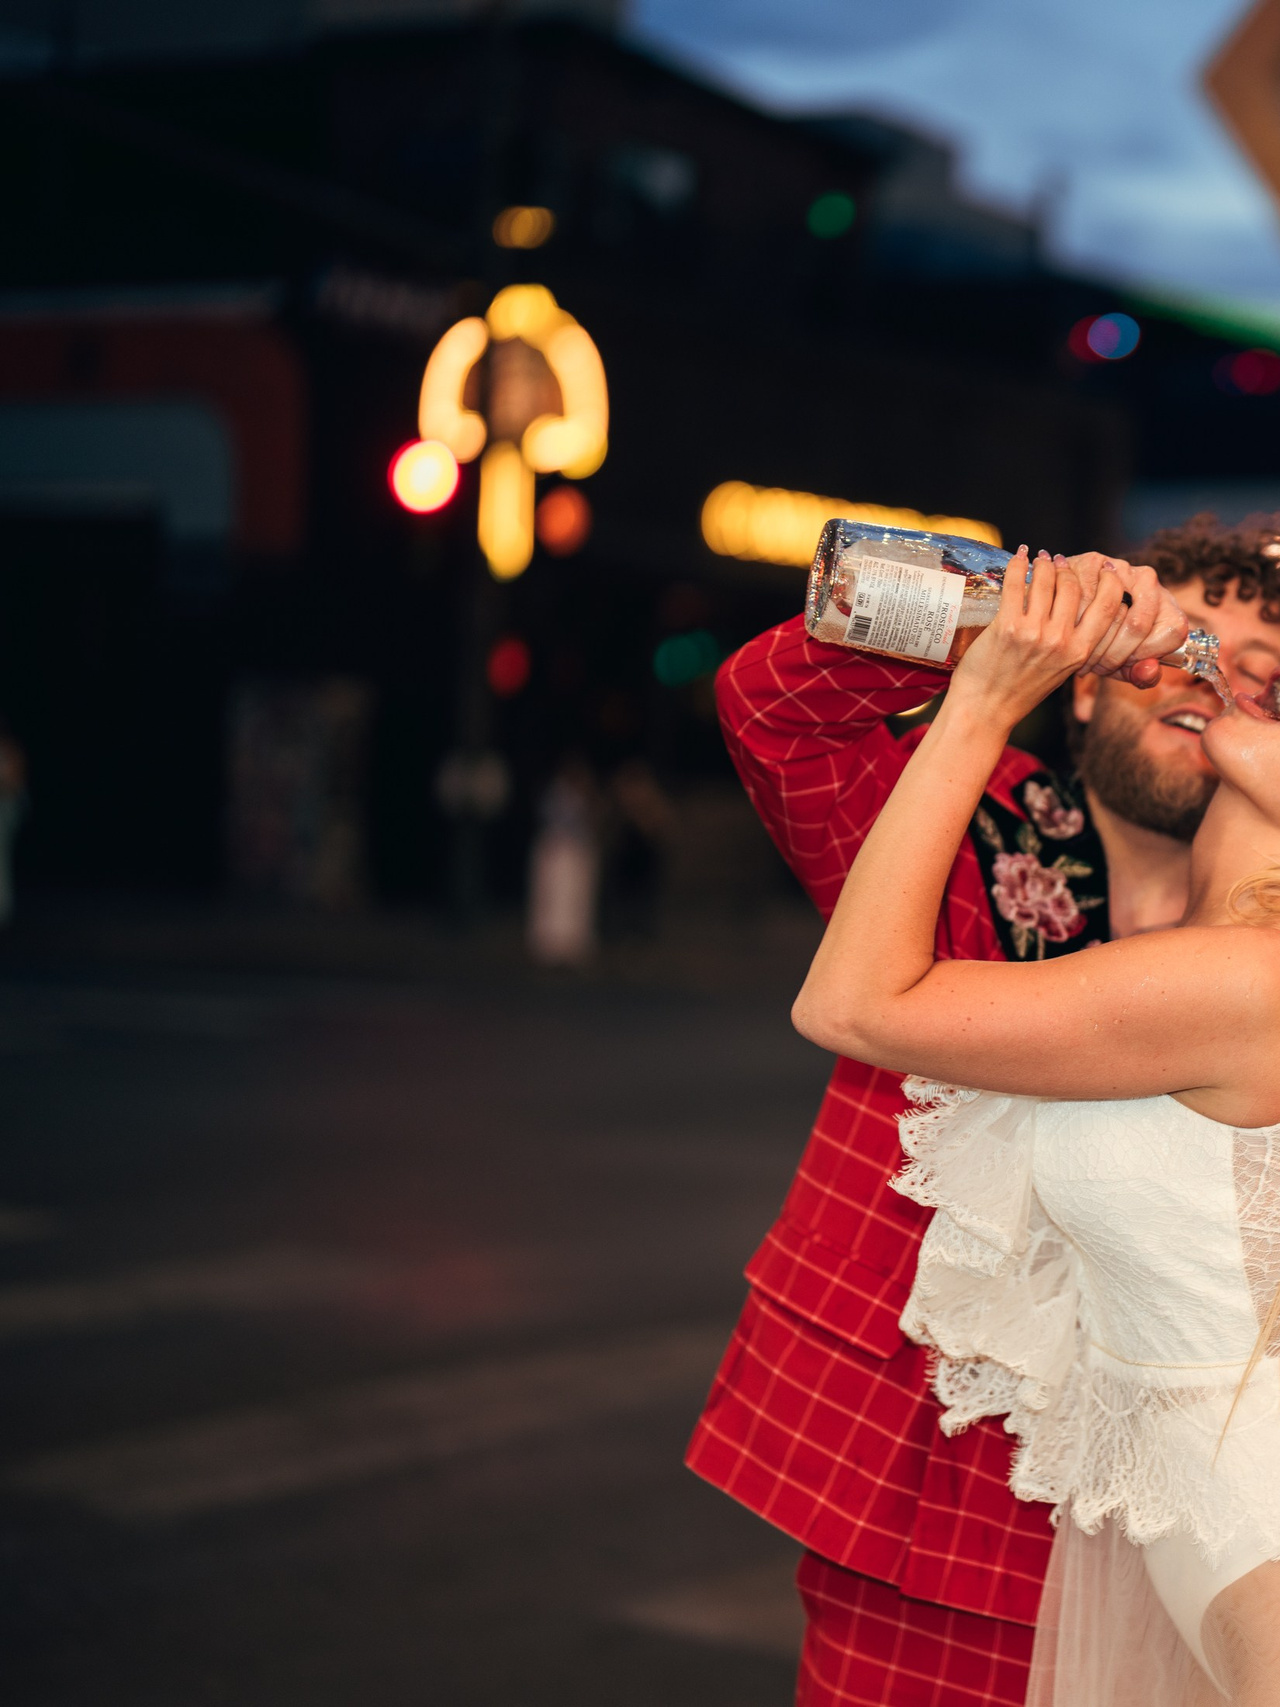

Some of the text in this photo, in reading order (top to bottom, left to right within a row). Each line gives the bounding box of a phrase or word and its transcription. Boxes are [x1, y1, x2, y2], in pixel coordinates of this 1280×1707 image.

[912, 589, 925, 632] MILLESIMATO
[923, 610, 933, 631] ROSÉ
[932, 602, 948, 643] PROSECCO
